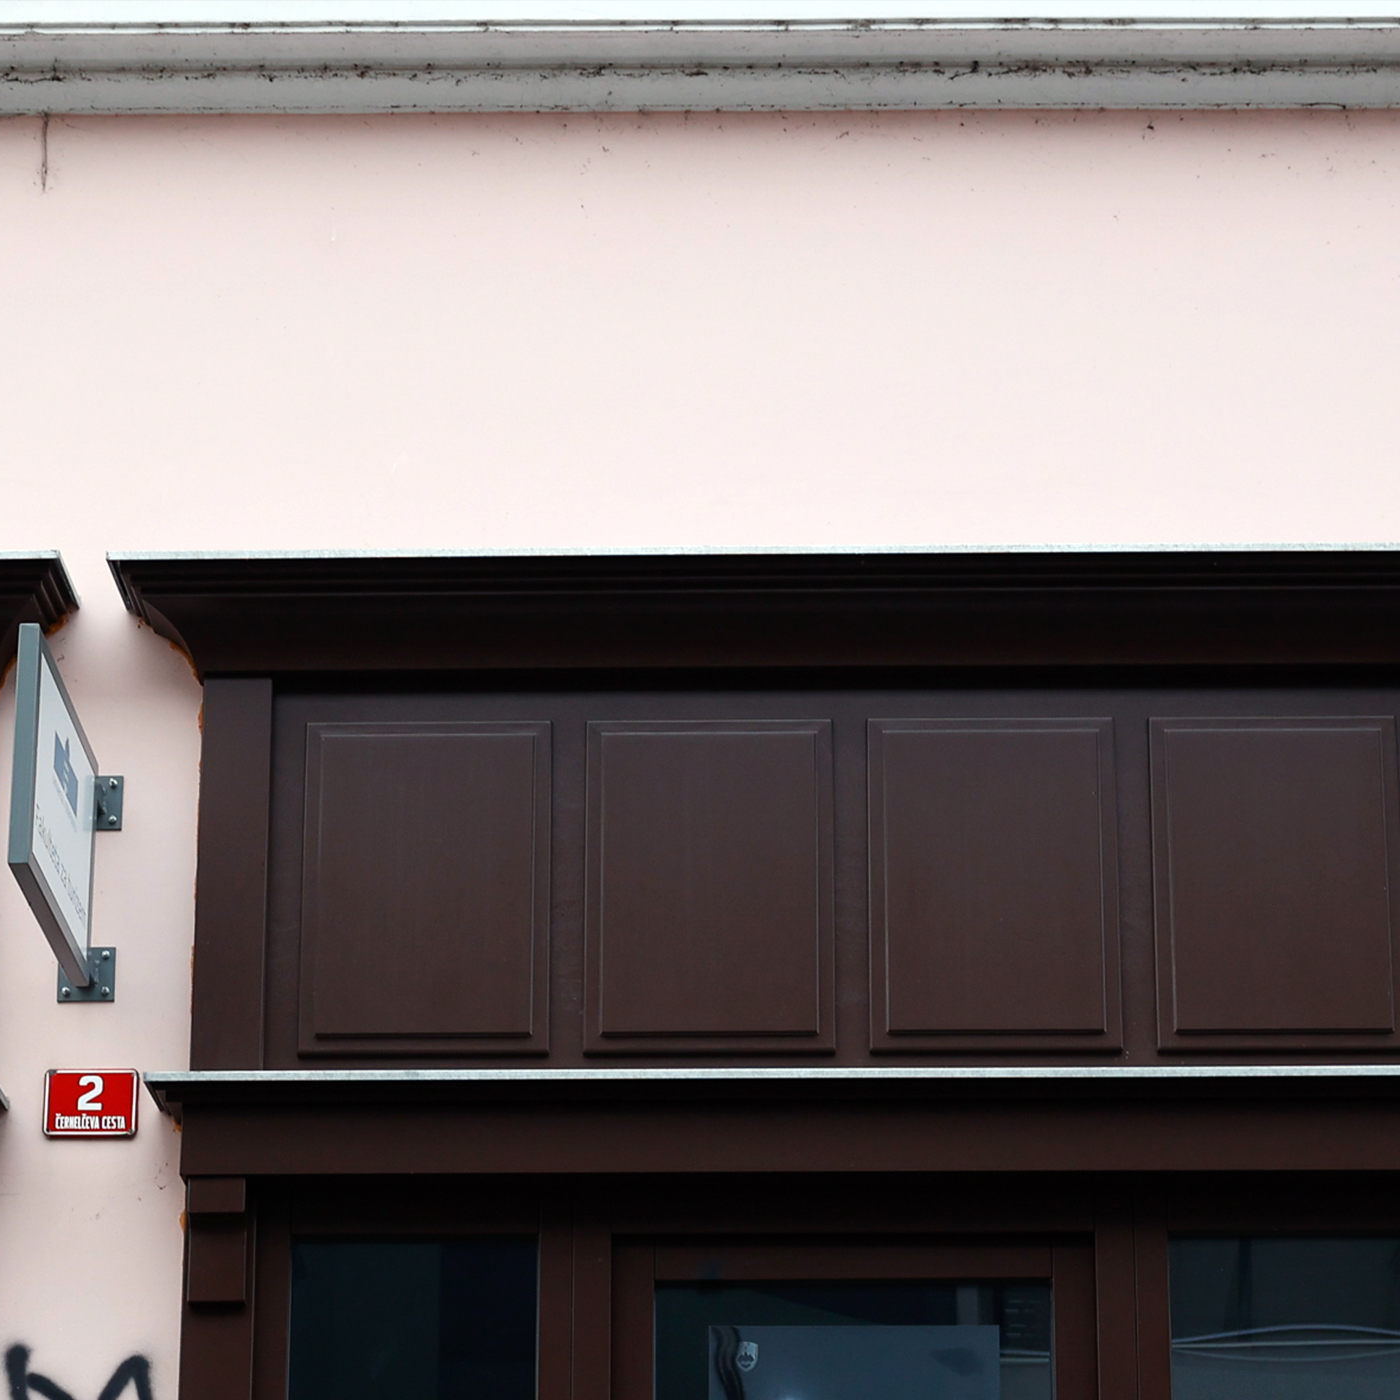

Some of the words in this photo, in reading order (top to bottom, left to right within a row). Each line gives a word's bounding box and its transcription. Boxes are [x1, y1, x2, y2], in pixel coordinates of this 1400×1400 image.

[77, 1075, 104, 1111] 2
[55, 1113, 100, 1130] ČERNELČEVA
[101, 1116, 126, 1130] CESTA
